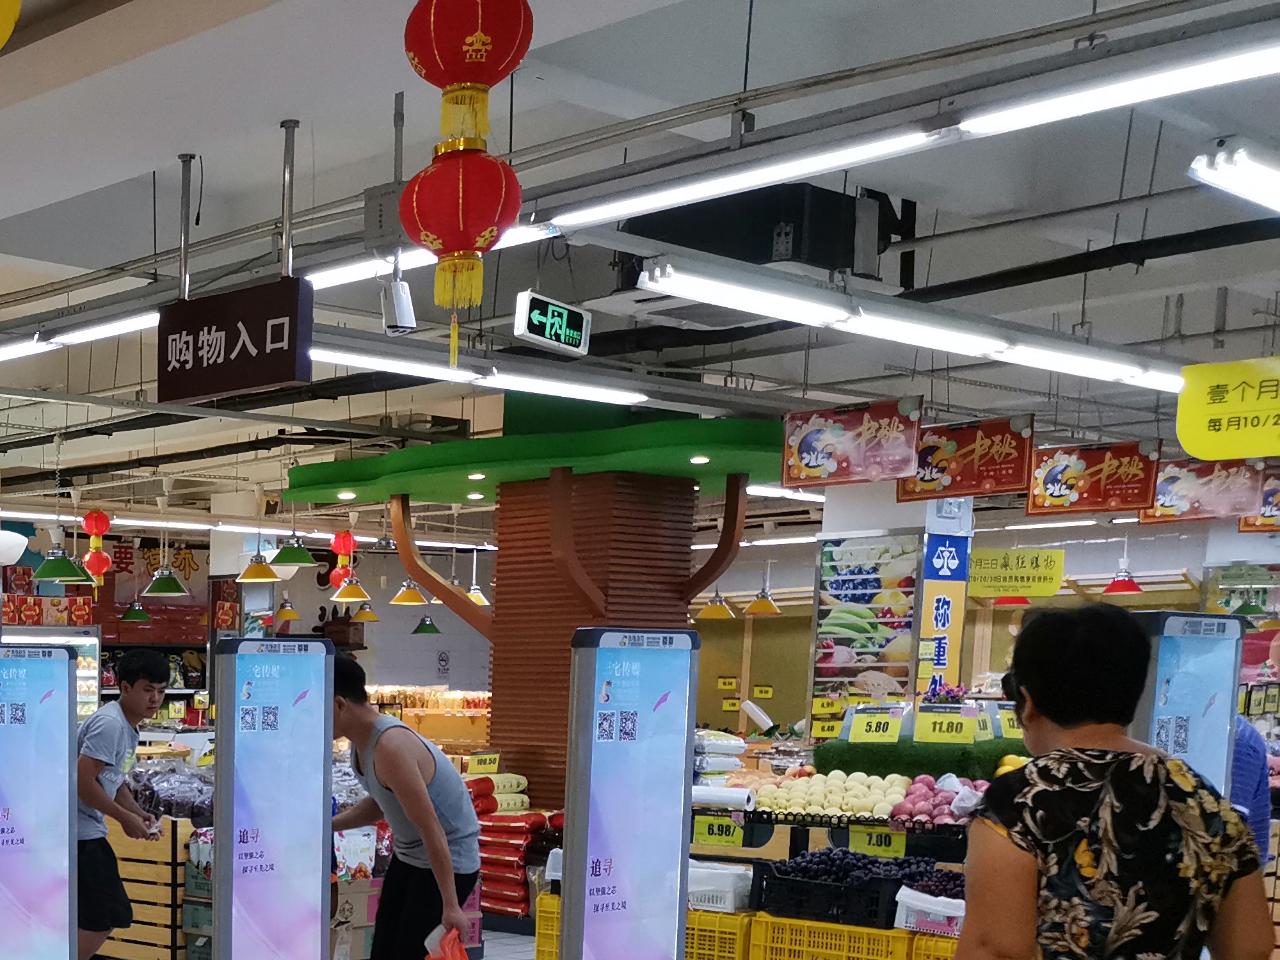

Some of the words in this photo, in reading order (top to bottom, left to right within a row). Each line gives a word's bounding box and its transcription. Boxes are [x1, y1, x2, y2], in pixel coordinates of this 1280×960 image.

[167, 315, 291, 373] 购物入口
[865, 721, 889, 733] 5.80
[931, 720, 964, 734] 11.80
[590, 858, 614, 877] 追寻
